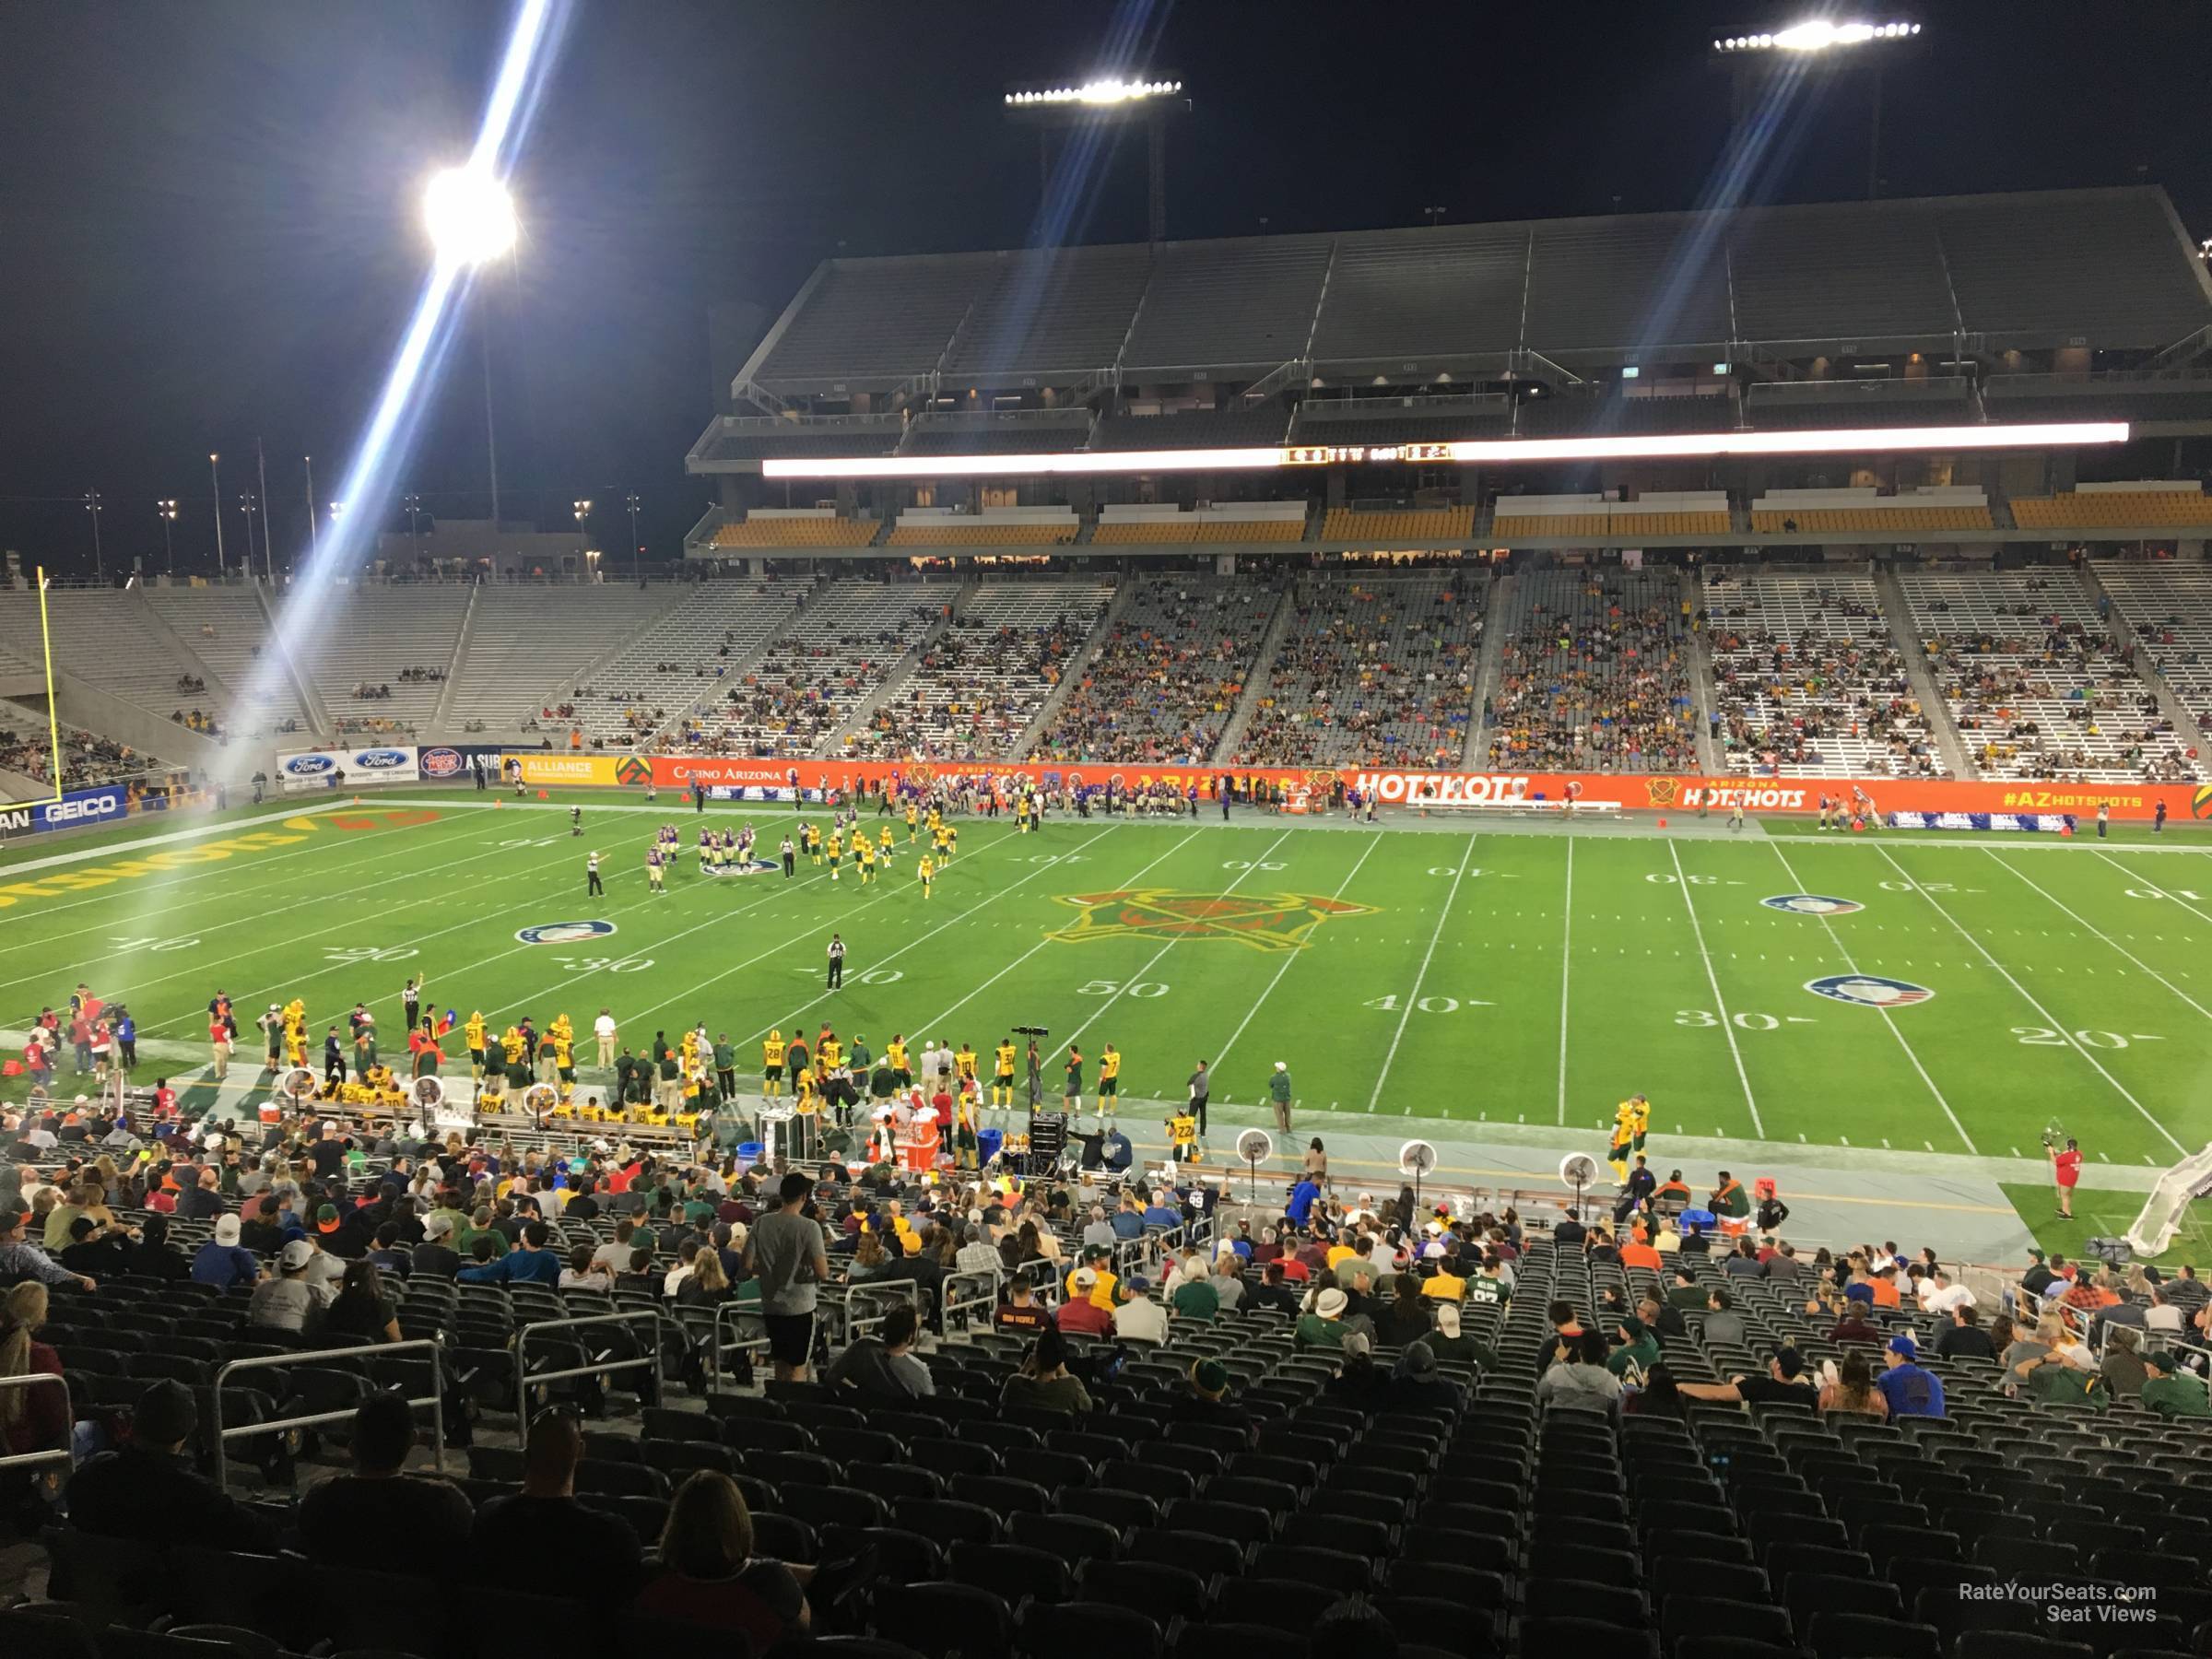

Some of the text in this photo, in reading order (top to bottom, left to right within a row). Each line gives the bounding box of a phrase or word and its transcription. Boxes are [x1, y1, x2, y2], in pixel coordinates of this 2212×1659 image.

[294, 758, 325, 772] Ford
[364, 751, 397, 766] Ford
[527, 761, 592, 771] ALLIANCE
[724, 768, 782, 781] ARIZONA
[1355, 773, 1529, 803] HOTSHOTS
[2004, 792, 2143, 807] #AZHOTSHOTS
[45, 794, 116, 822] GEICO
[1222, 860, 1289, 872] 50
[1645, 874, 1718, 885] 30
[324, 947, 420, 962] 20
[562, 957, 656, 974] 30
[1077, 980, 1171, 998] 50
[1362, 994, 1460, 1014] 40
[1674, 1009, 1781, 1031] 30
[2010, 1026, 2130, 1051] 20
[768, 1049, 780, 1059] 28
[962, 1062, 971, 1073] 10
[482, 1101, 496, 1112] 20
[1189, 1196, 1204, 1208] 99
